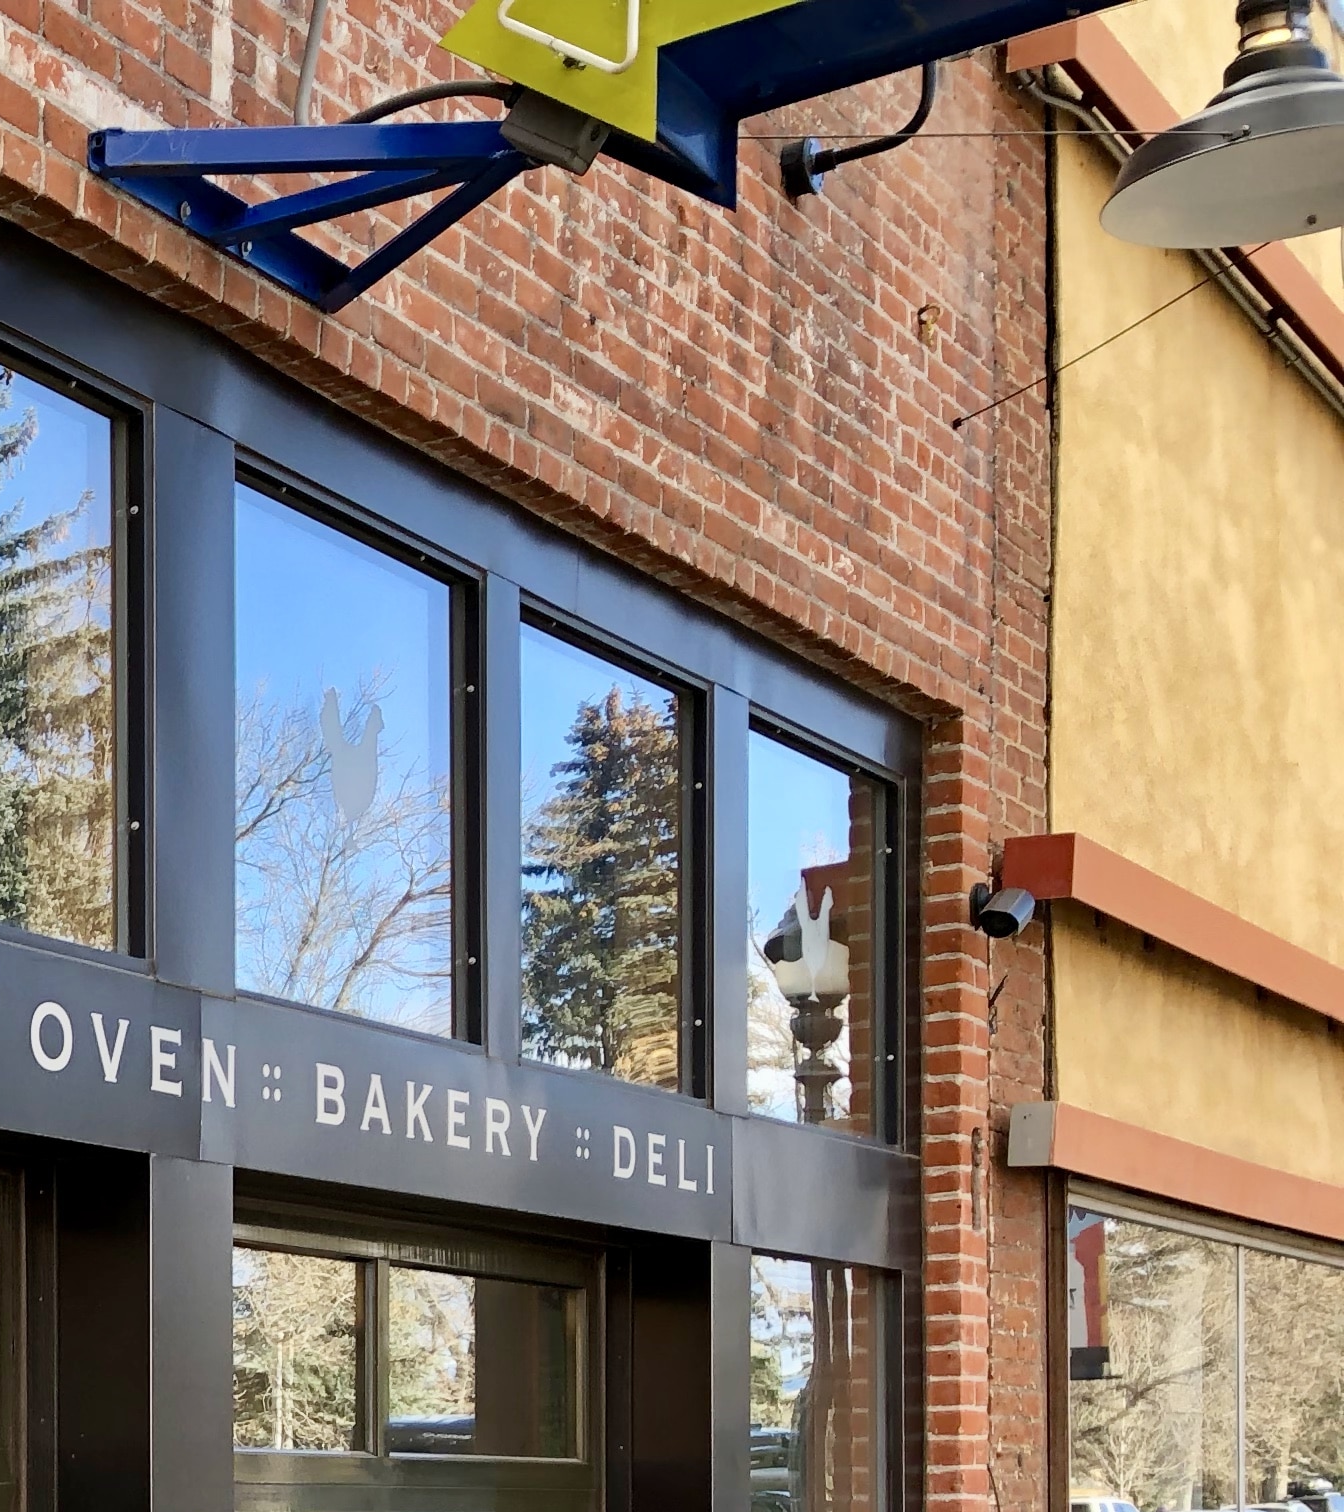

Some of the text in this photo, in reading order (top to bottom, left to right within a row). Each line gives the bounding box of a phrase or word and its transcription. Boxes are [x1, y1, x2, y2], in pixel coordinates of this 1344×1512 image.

[30, 1001, 237, 1109] OVEN
[315, 1062, 548, 1162] BAKERY
[612, 1125, 714, 1195] DELI
